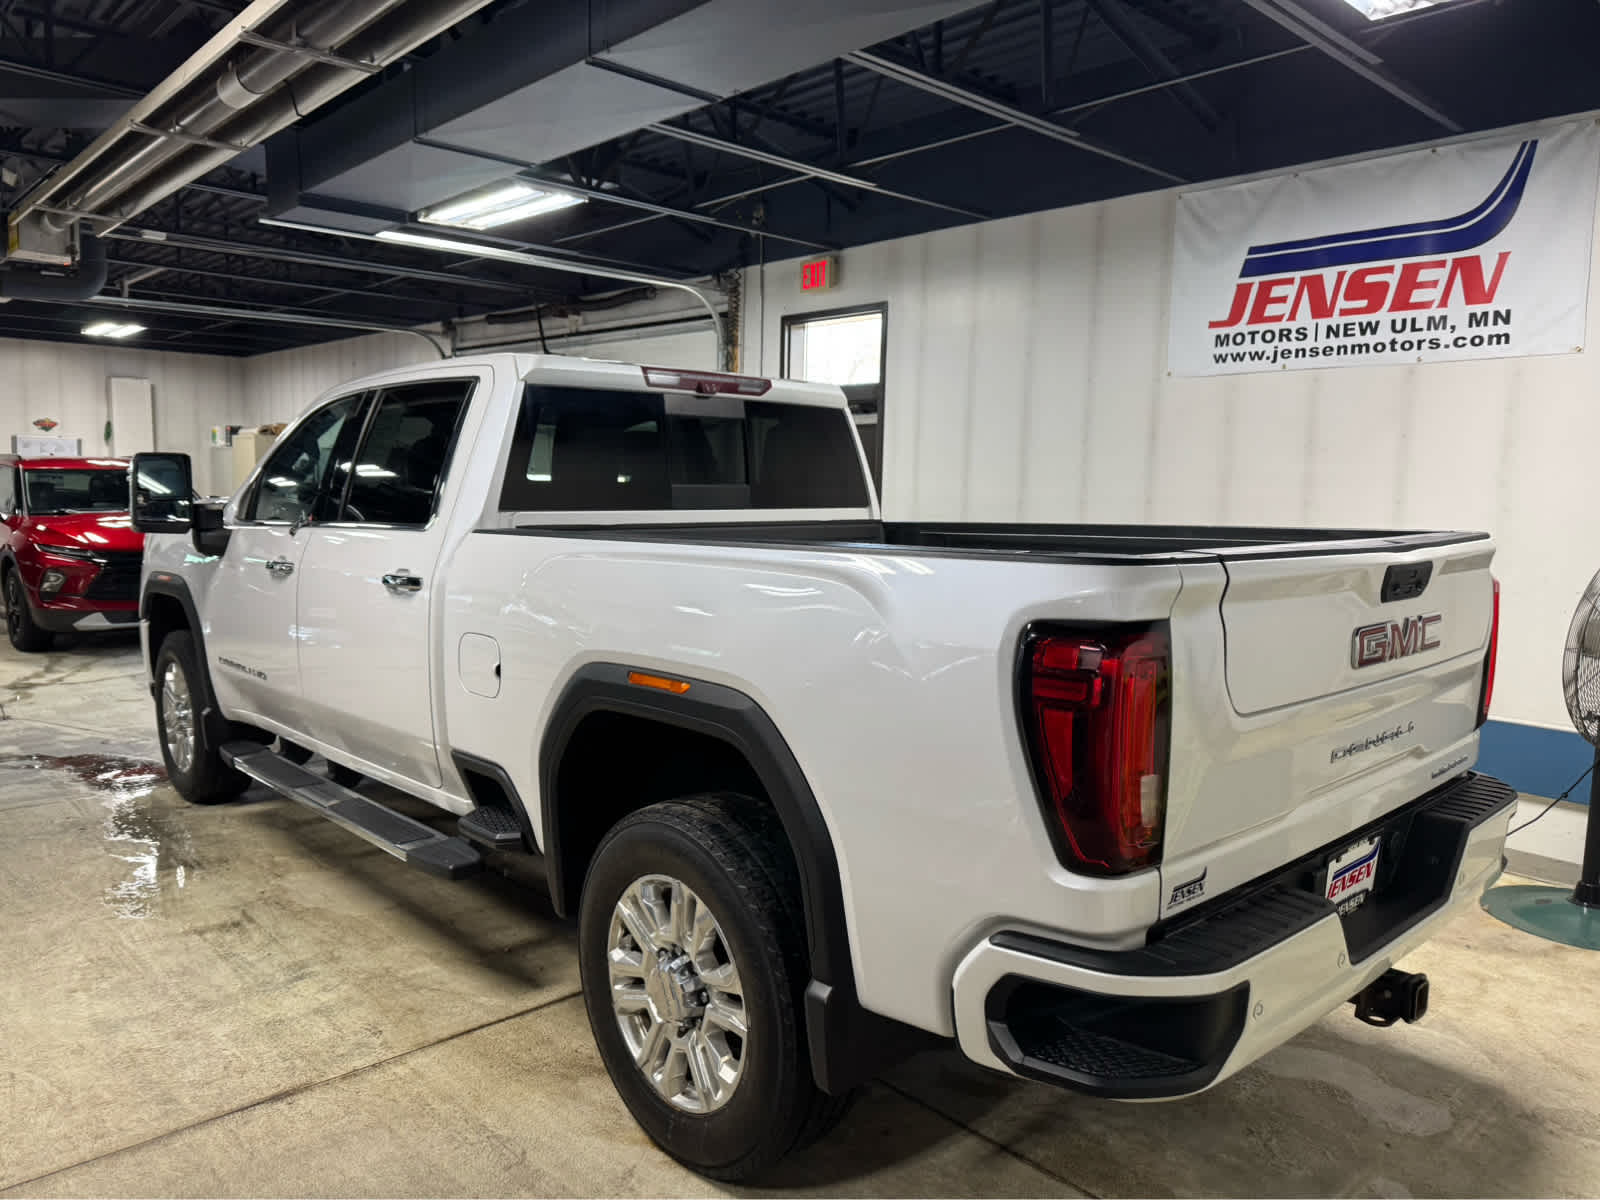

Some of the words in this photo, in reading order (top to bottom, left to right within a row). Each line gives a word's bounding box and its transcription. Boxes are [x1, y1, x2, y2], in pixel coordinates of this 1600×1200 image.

[802, 260, 828, 291] EXIT
[1208, 251, 1512, 329] JENSEN
[1213, 332, 1511, 364] www.jensenmotors.com
[1214, 326, 1308, 348] MOTORS
[1325, 320, 1381, 340] NEW
[1390, 315, 1457, 334] ULM,
[1468, 309, 1512, 329] MN
[1351, 612, 1442, 669] GMC
[1327, 860, 1376, 899] JENSEN
